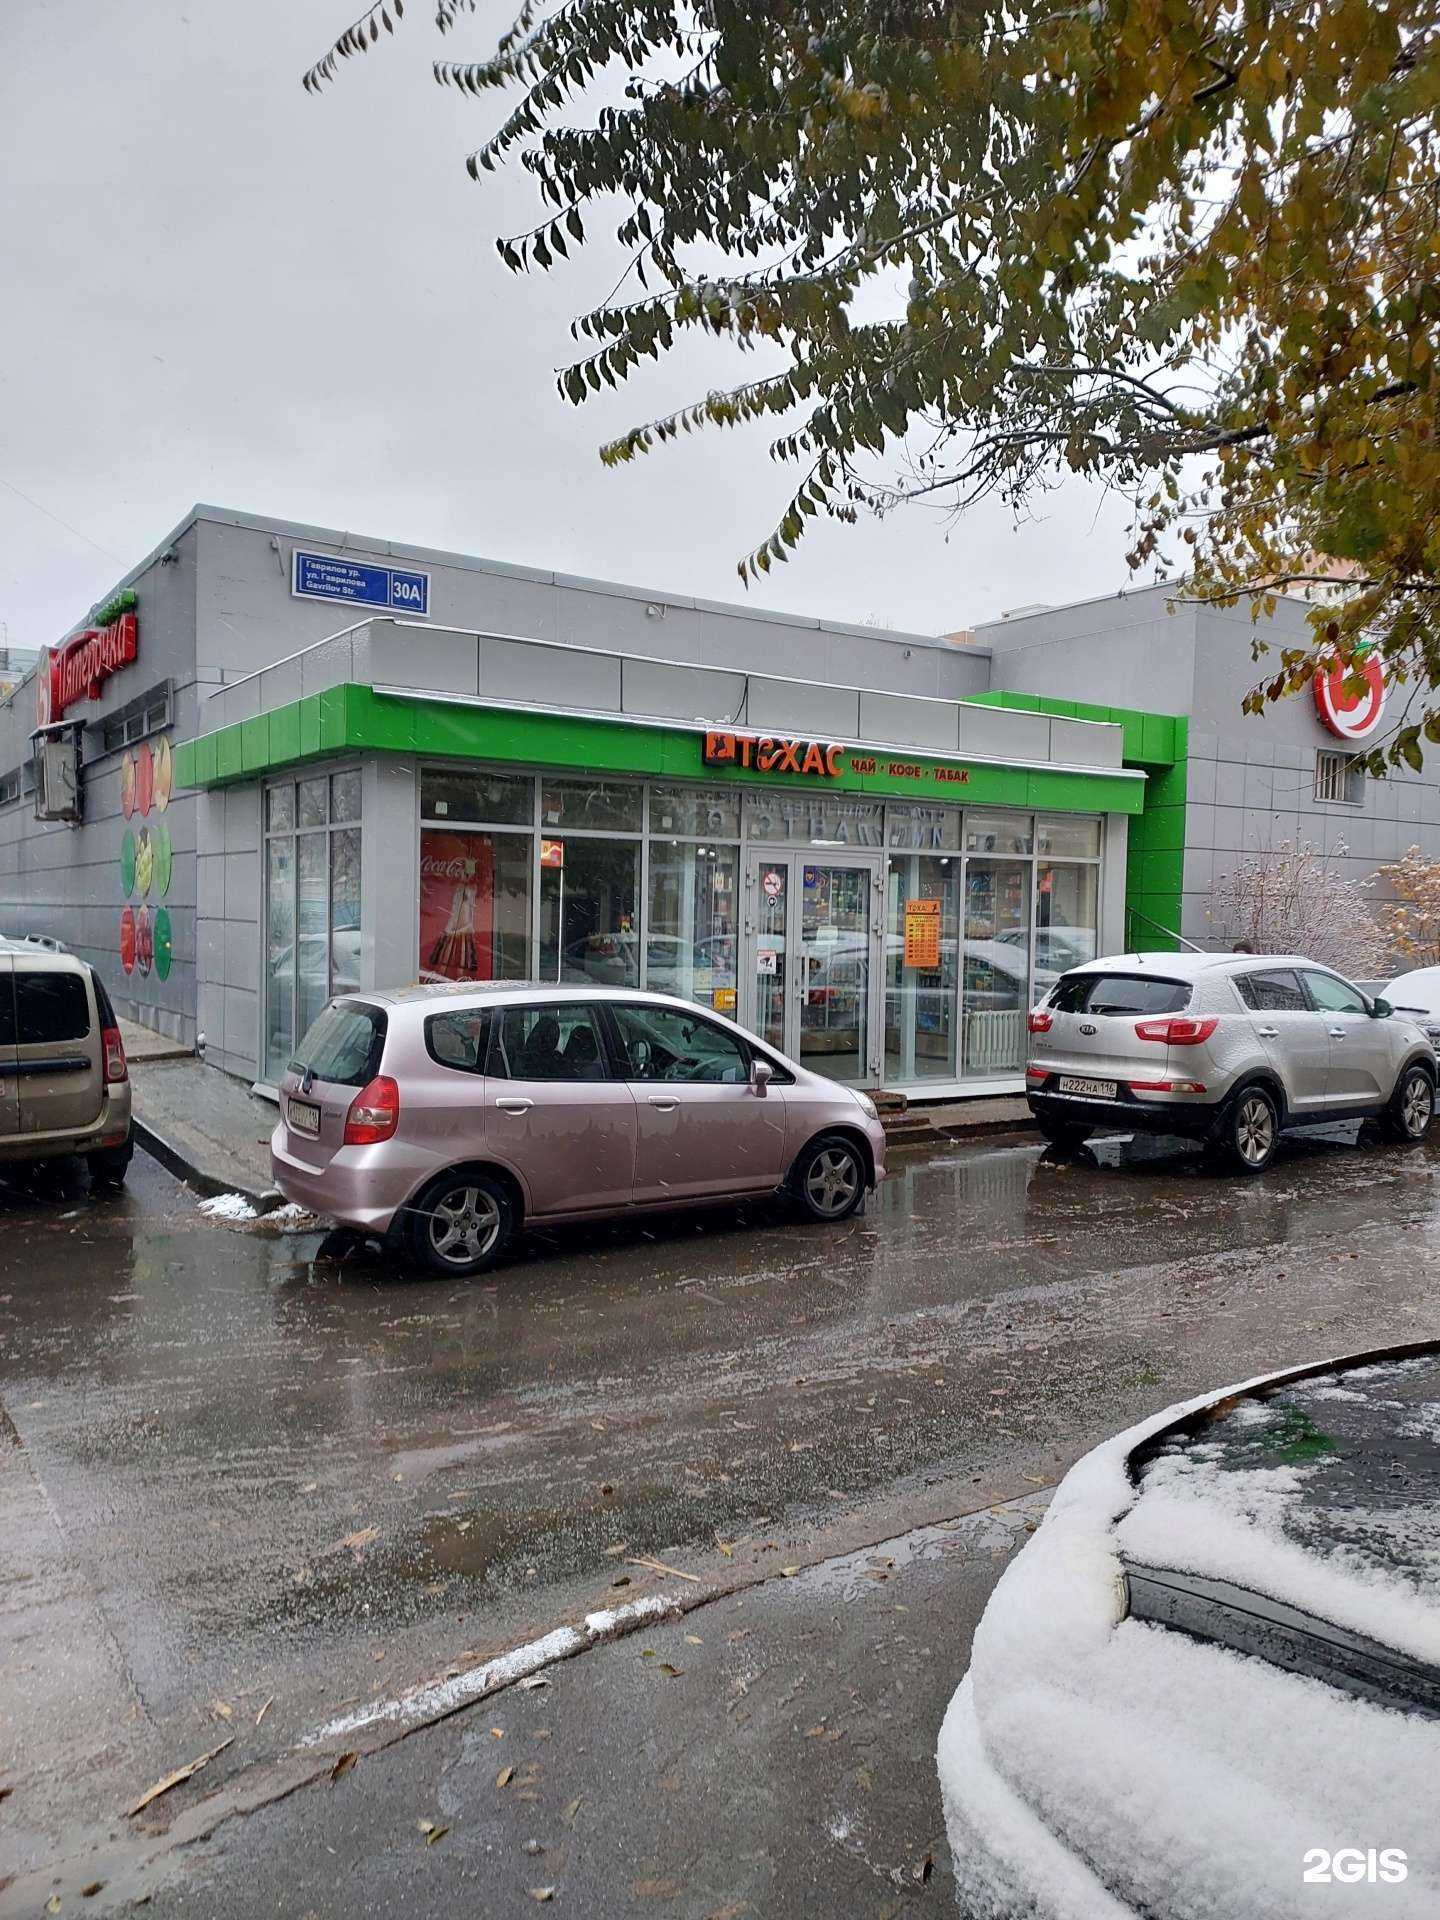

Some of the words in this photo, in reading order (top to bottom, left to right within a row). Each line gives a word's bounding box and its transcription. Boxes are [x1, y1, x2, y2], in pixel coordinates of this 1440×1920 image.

[306, 560, 347, 574] Гаврилов
[348, 568, 361, 578] ур.
[306, 572, 318, 580] ул.
[321, 574, 366, 587] Гаврилова
[306, 581, 341, 593] Gavrilov
[342, 587, 356, 595] Str.
[393, 581, 421, 602] 30А
[851, 758, 876, 773] ЧАЙ
[889, 763, 921, 778] КОФЕ
[934, 767, 969, 784] ТАБАК
[1081, 1025, 1095, 1035] KIA
